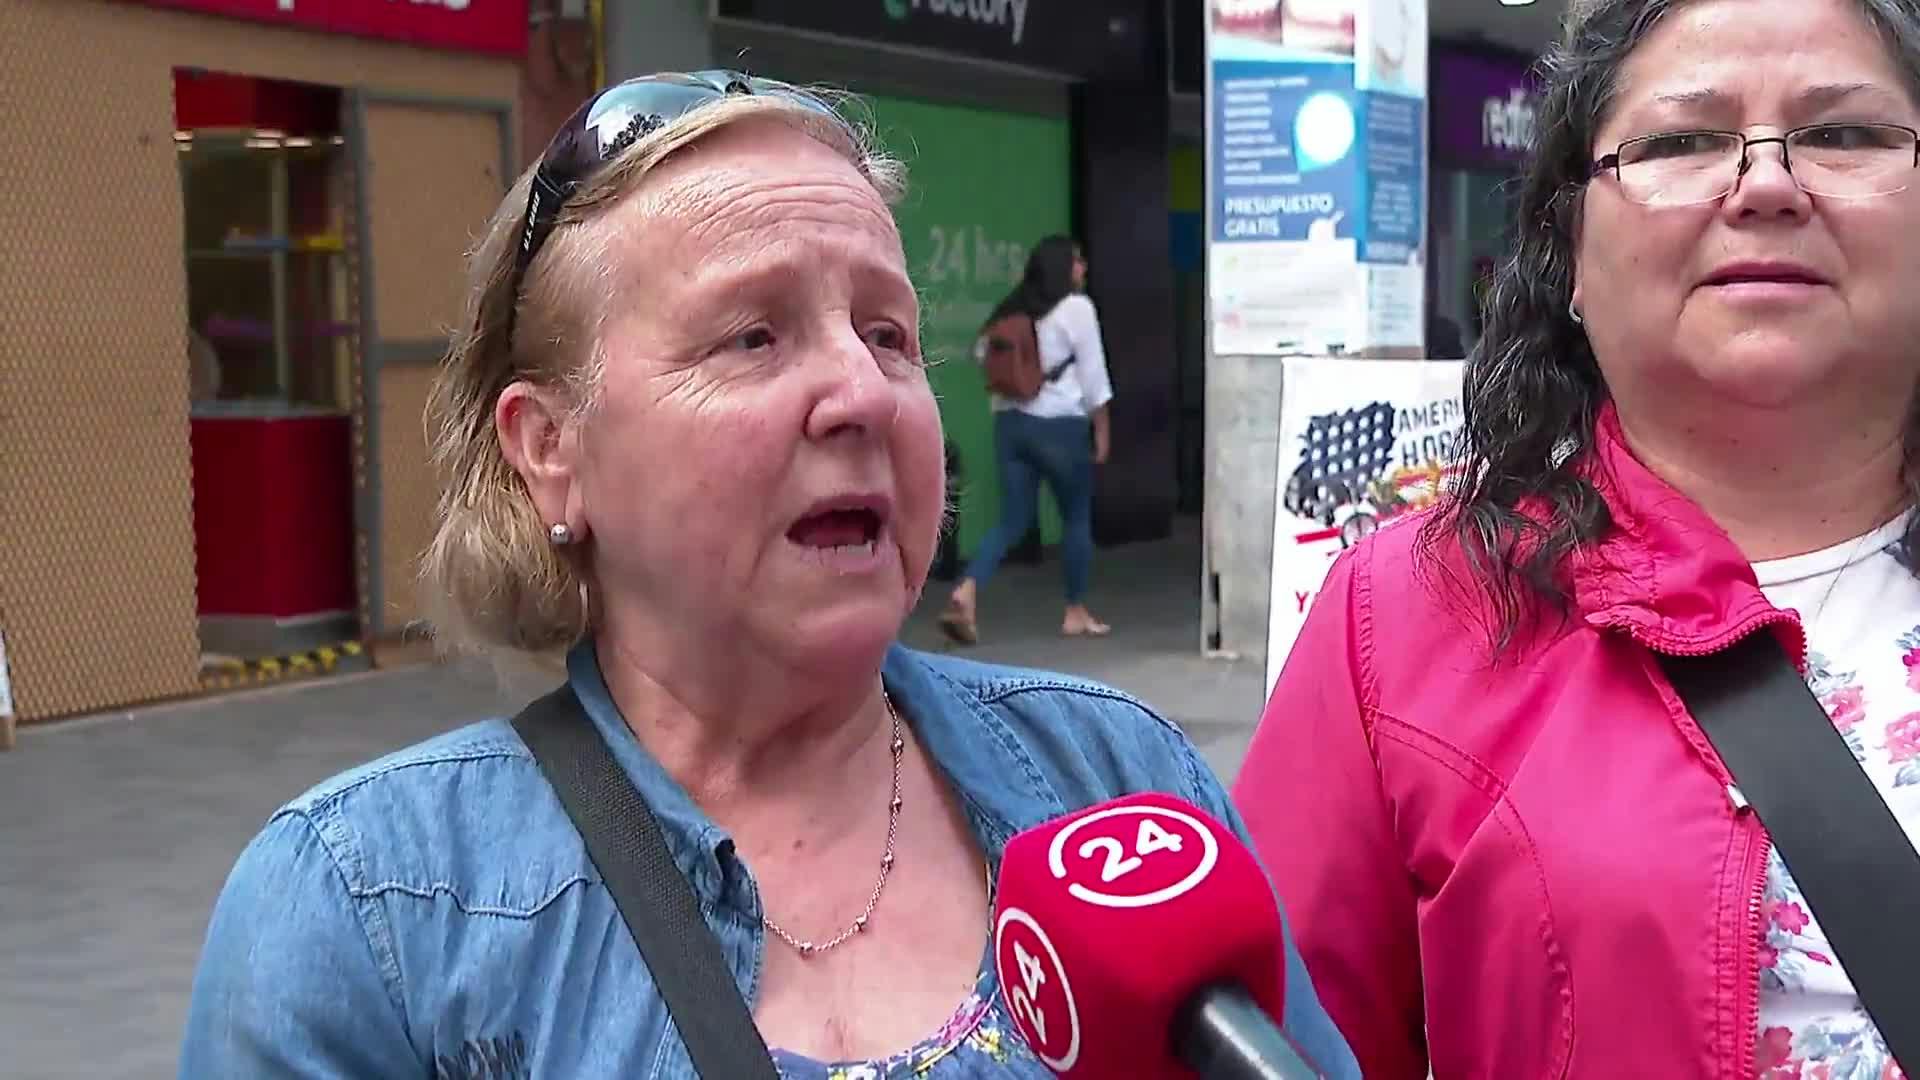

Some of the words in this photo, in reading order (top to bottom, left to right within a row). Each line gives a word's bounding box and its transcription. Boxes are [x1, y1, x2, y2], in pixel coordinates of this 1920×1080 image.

[1224, 193, 1334, 215] PRESUPUESTO
[1224, 216, 1280, 237] GRATIS
[1079, 818, 1183, 883] 24
[1012, 940, 1047, 1046] 24
